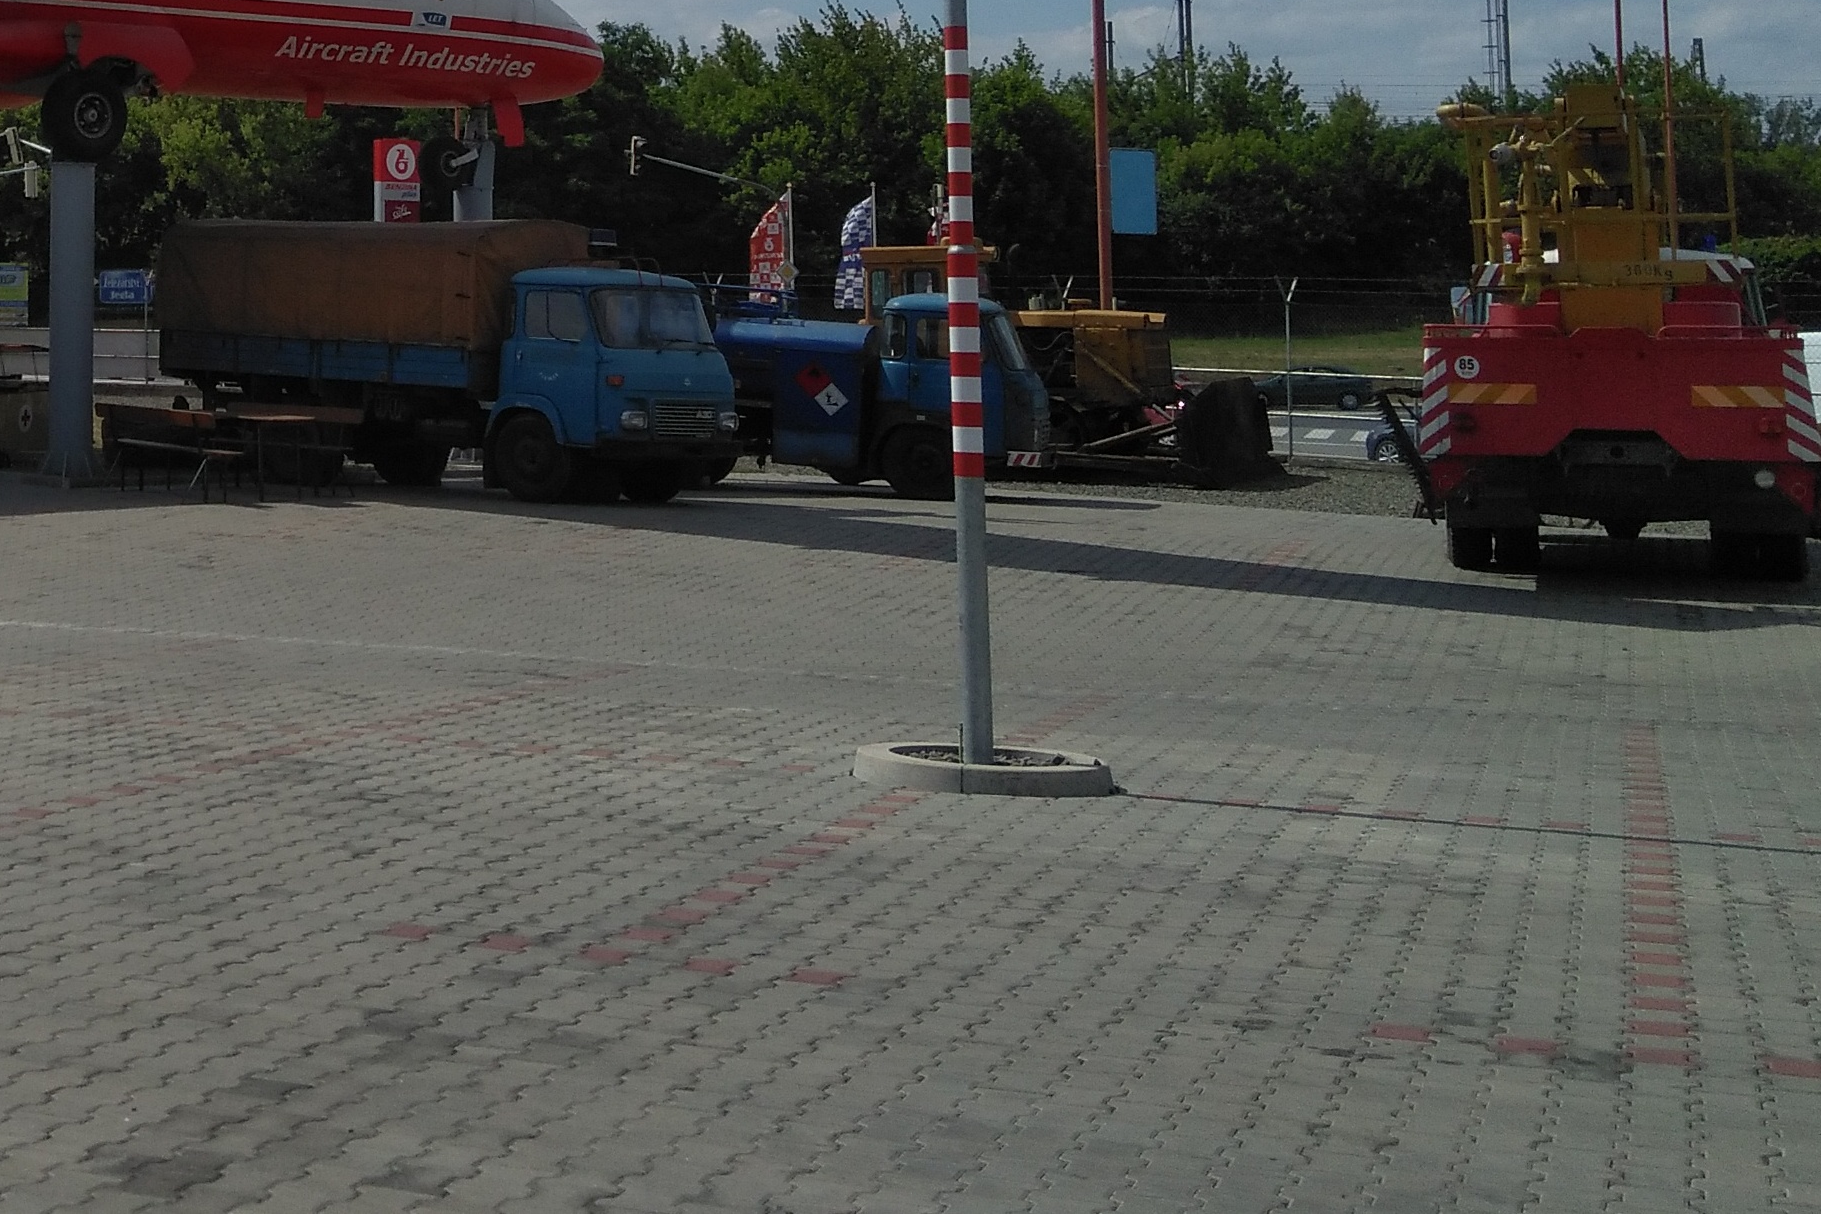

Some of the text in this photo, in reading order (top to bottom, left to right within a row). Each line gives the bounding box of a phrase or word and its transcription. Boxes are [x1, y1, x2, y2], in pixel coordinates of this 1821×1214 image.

[275, 36, 535, 78] Aircraft Industries
[1459, 358, 1475, 370] 85
